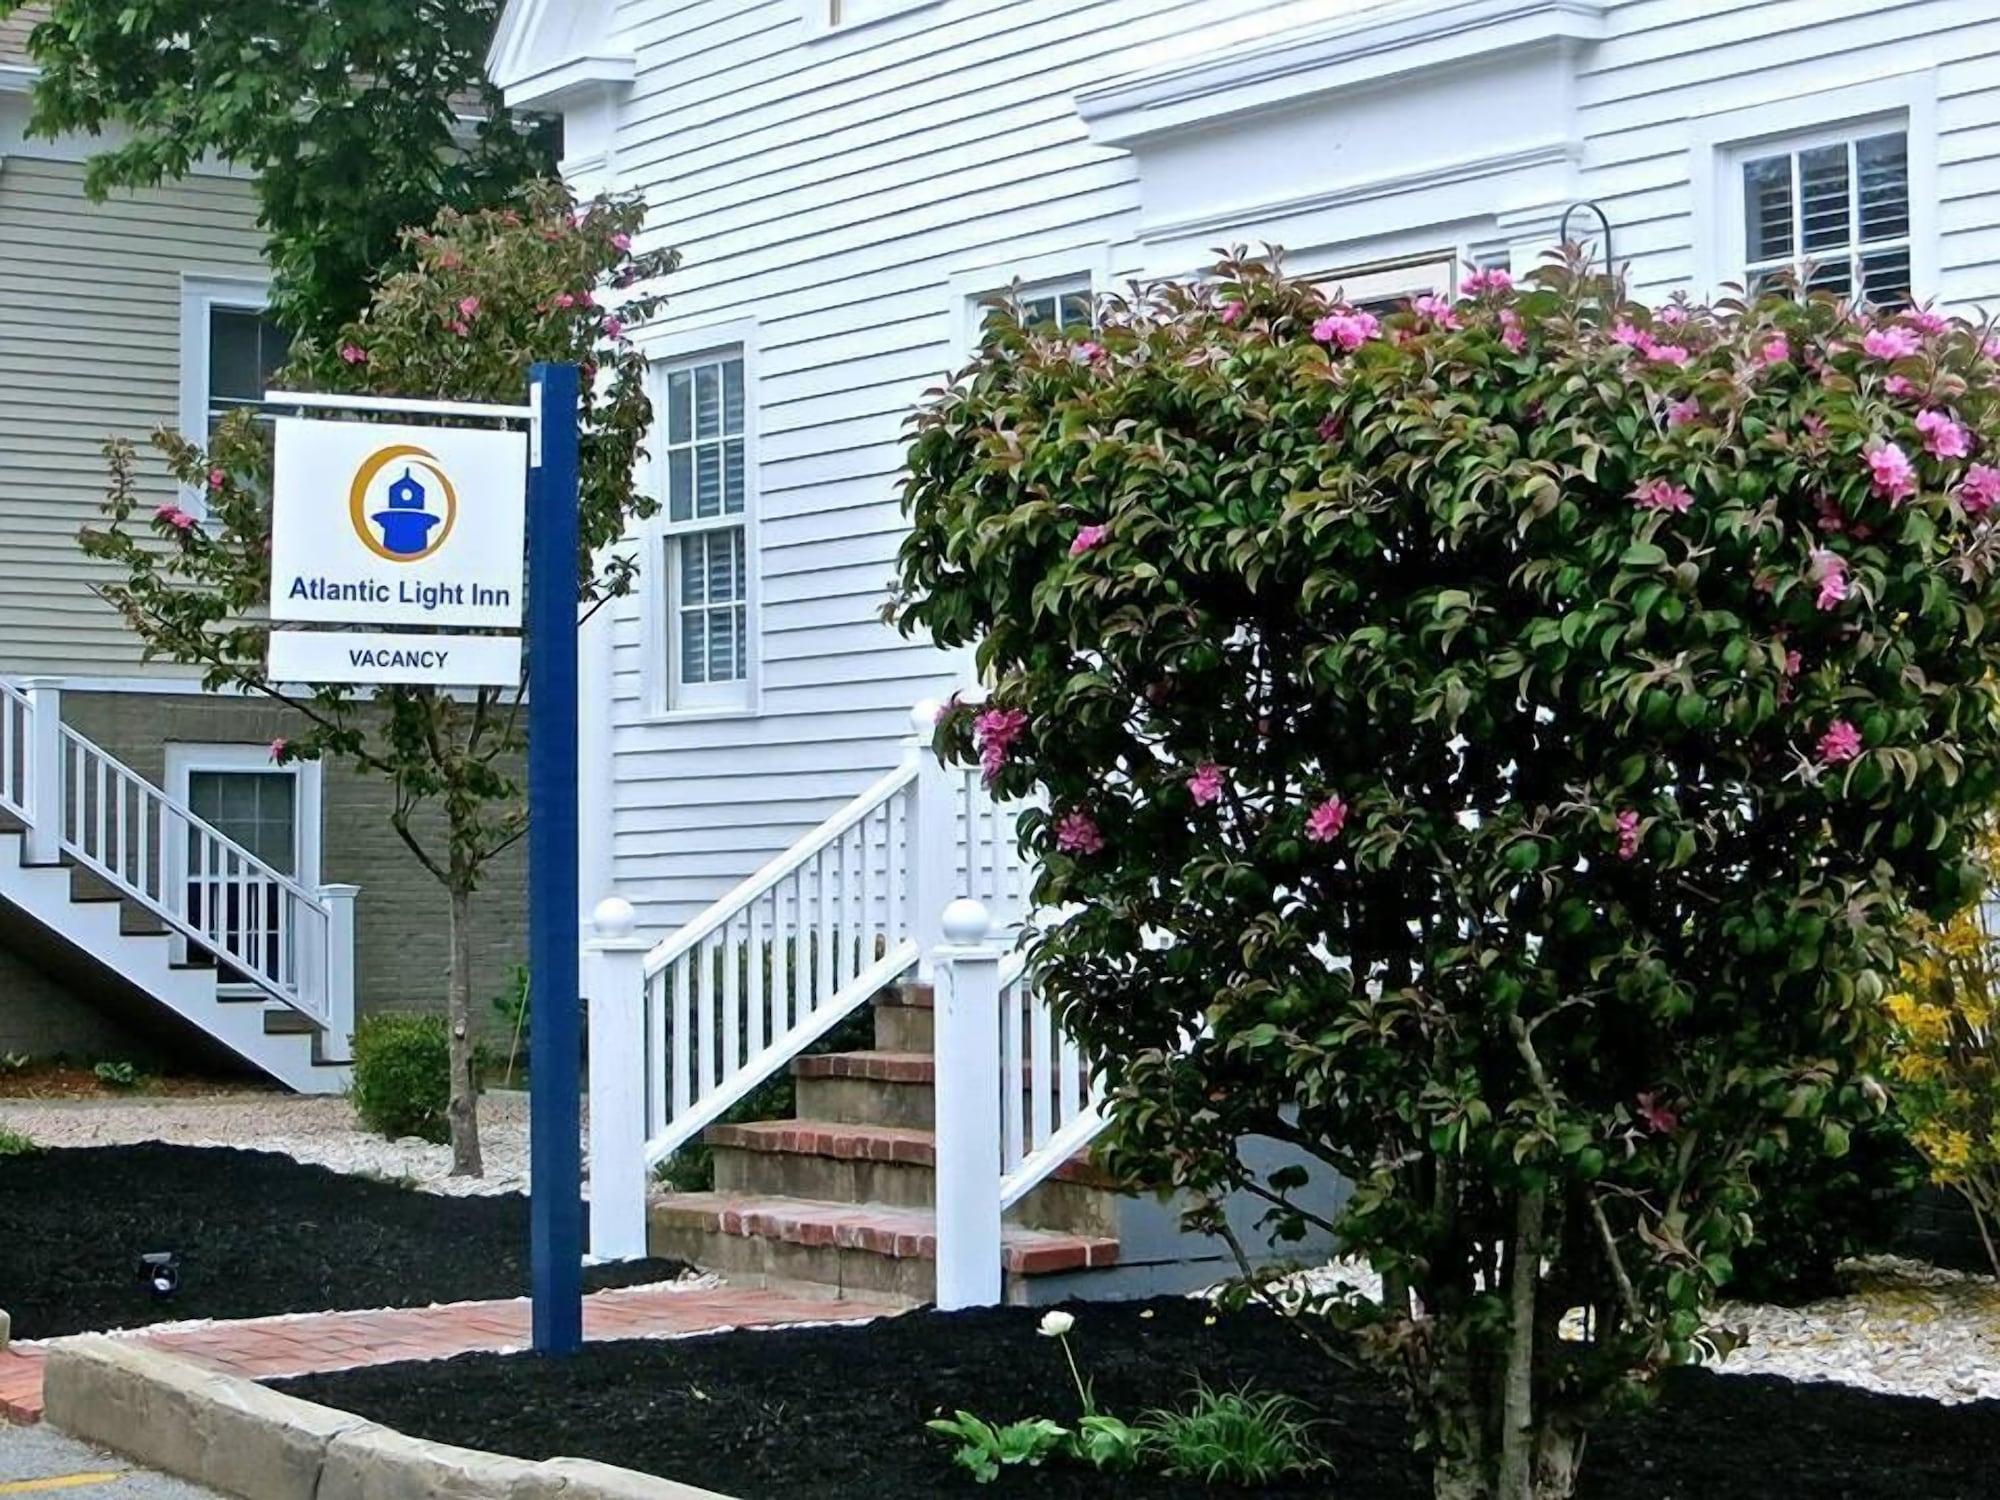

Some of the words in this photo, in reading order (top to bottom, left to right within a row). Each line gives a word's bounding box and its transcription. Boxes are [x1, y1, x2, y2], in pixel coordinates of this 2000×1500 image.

[289, 576, 390, 603] Atlantic
[399, 580, 465, 610] Light
[472, 583, 510, 606] Inn
[349, 649, 449, 669] VACANCY
